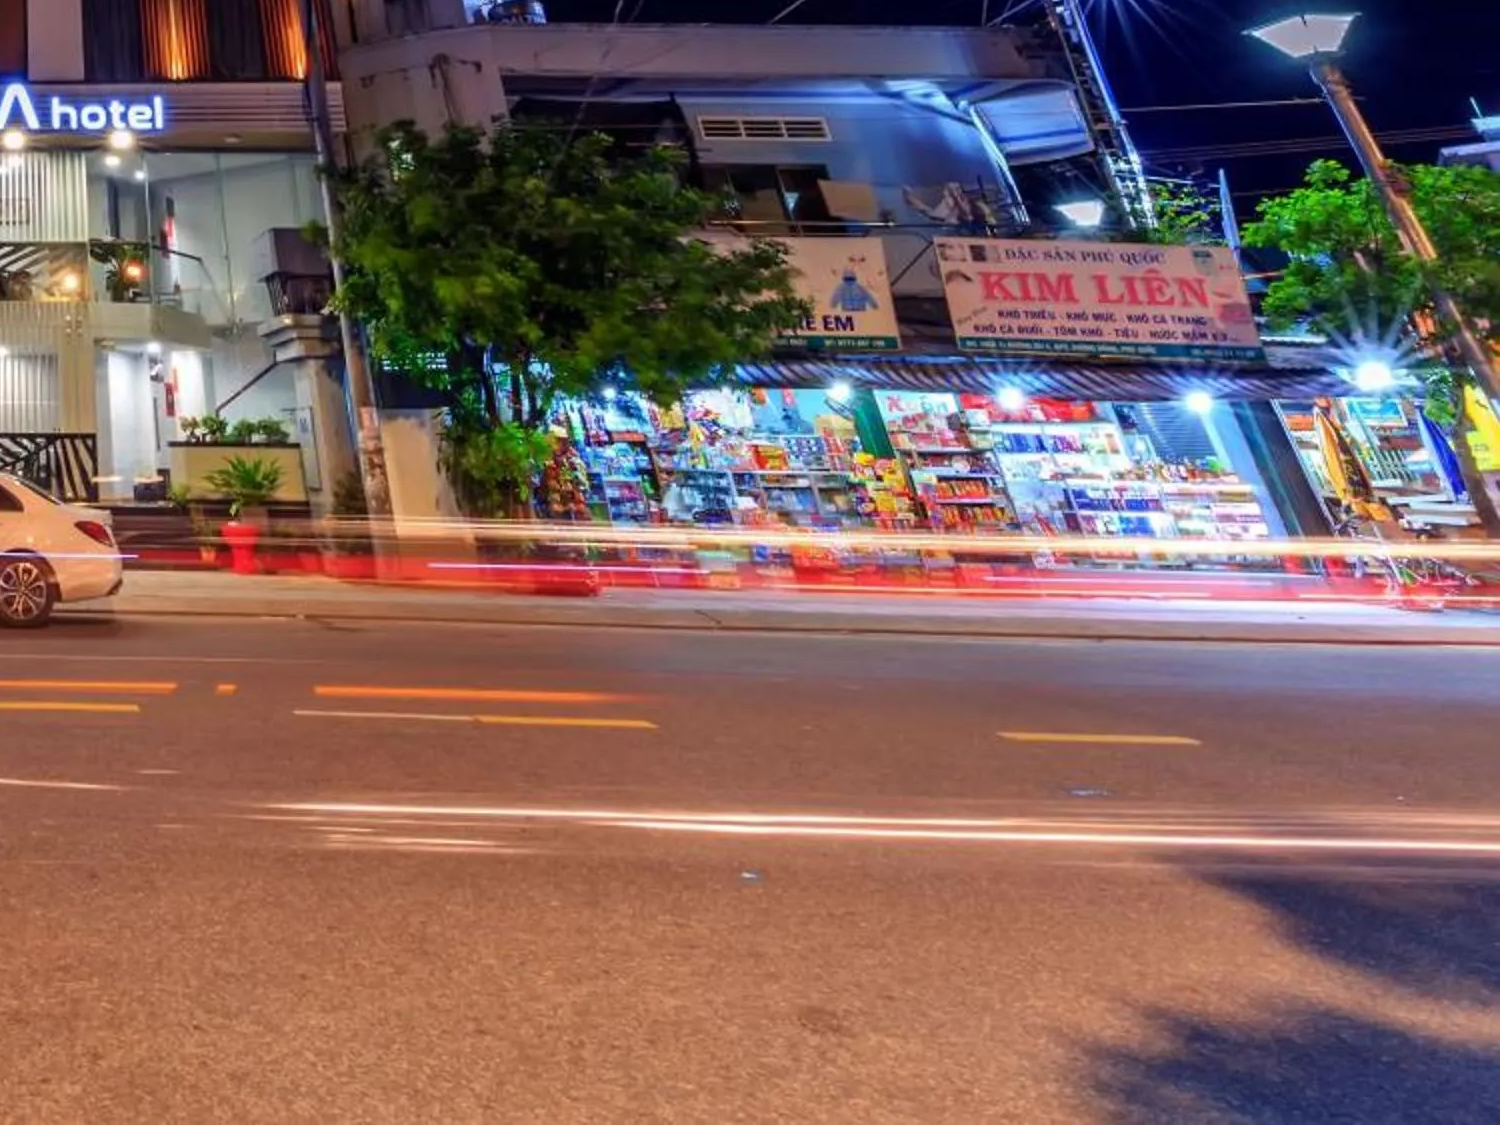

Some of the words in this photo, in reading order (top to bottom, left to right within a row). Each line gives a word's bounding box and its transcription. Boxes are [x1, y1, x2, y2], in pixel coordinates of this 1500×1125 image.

[51, 96, 164, 130] hotel
[978, 271, 1080, 304] KIM
[1092, 269, 1211, 308] LIÊN
[823, 314, 856, 332] EM
